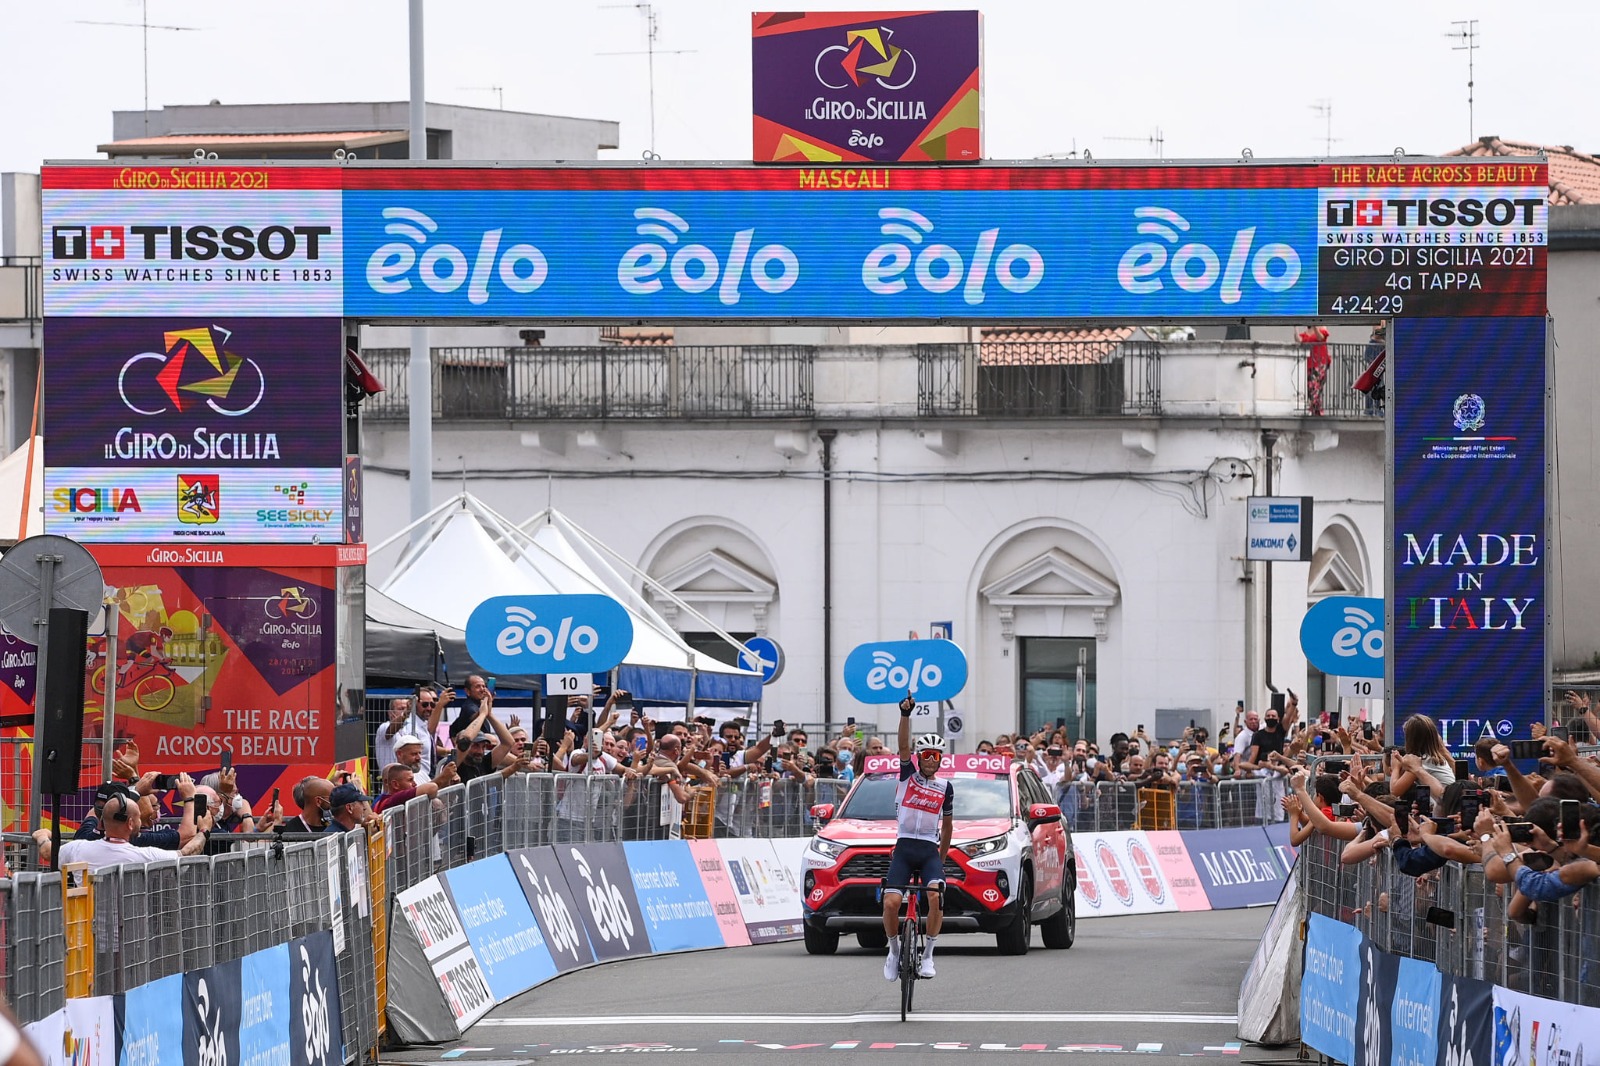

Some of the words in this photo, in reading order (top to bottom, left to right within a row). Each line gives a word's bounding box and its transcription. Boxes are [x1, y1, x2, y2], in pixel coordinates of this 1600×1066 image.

[812, 97, 856, 120] GIRO
[866, 97, 927, 120] SICILIA
[848, 132, 884, 149] eolo
[120, 168, 161, 189] GIRO
[170, 167, 227, 188] SICILIA
[230, 171, 269, 189] 2021
[799, 169, 890, 189] MASCALI
[1331, 166, 1361, 183] THE
[1366, 166, 1406, 183] RACE
[1412, 166, 1472, 183] ACROSS
[1478, 165, 1539, 182] BEAUTY
[1387, 198, 1544, 227] TISSOT
[130, 225, 332, 261] TISSOT
[1326, 232, 1374, 244] SWISS
[1382, 232, 1451, 244] WATCHES
[1460, 232, 1504, 244] SINCE
[1512, 232, 1544, 243] 1853
[365, 226, 549, 306] eolo
[617, 226, 800, 306] eolo
[861, 226, 1045, 306] eolo
[1117, 225, 1302, 304] eolo
[1333, 248, 1385, 267] GIRO
[1391, 248, 1411, 267] DI
[1417, 248, 1484, 267] SICILIA
[1490, 247, 1534, 266] 2021
[52, 268, 114, 282] SWISS
[125, 268, 214, 282] WATCHES
[225, 268, 282, 282] SINCE
[292, 268, 333, 282] 1853
[1385, 272, 1412, 290] 4a
[1418, 272, 1482, 290] TAPPA
[1331, 295, 1404, 314] 4:24:29
[115, 427, 178, 460] GIRO
[193, 427, 281, 460] SICILIA
[1459, 445, 1472, 453] degli
[1440, 452, 1477, 460] Cooperazione
[53, 487, 142, 513] SICILIA
[256, 509, 334, 522] SEESICILY
[1250, 538, 1285, 549] BANCOMAT
[1402, 533, 1539, 566] MADE
[185, 548, 224, 563] SICILIA
[1456, 572, 1484, 591] IN
[1405, 597, 1536, 630] ITALY
[291, 622, 322, 635] SICILIA
[496, 616, 599, 661] eolo
[282, 641, 300, 650] eolo
[1331, 626, 1384, 659] eo
[559, 676, 579, 691] 10
[866, 657, 943, 694] eolo
[1353, 681, 1372, 696] 10
[223, 709, 262, 730] THE
[269, 709, 320, 730] RACE
[916, 705, 930, 716] 25
[156, 735, 235, 756] ACROSS
[241, 735, 320, 756] BEAUTY
[868, 755, 900, 771] ene
[966, 755, 1006, 771] enel
[807, 858, 827, 867] TOYOTA
[976, 858, 1002, 868] TOYOTA
[1200, 848, 1265, 887] MADE
[1259, 860, 1278, 882] IN
[630, 867, 663, 890] Internet
[658, 863, 680, 888] dove
[413, 891, 459, 945] TISSOT
[458, 897, 493, 929] Internet
[483, 891, 507, 919] dove
[646, 896, 659, 930] gli
[655, 895, 673, 921] altri
[670, 902, 687, 920] non
[683, 893, 713, 919] arrivano
[479, 936, 494, 976] gli
[487, 930, 508, 963] altri
[501, 935, 520, 958] non
[513, 921, 544, 953] arrivano
[1328, 943, 1344, 986] dove
[445, 957, 490, 1014] TISSOT
[261, 978, 273, 1022] dove
